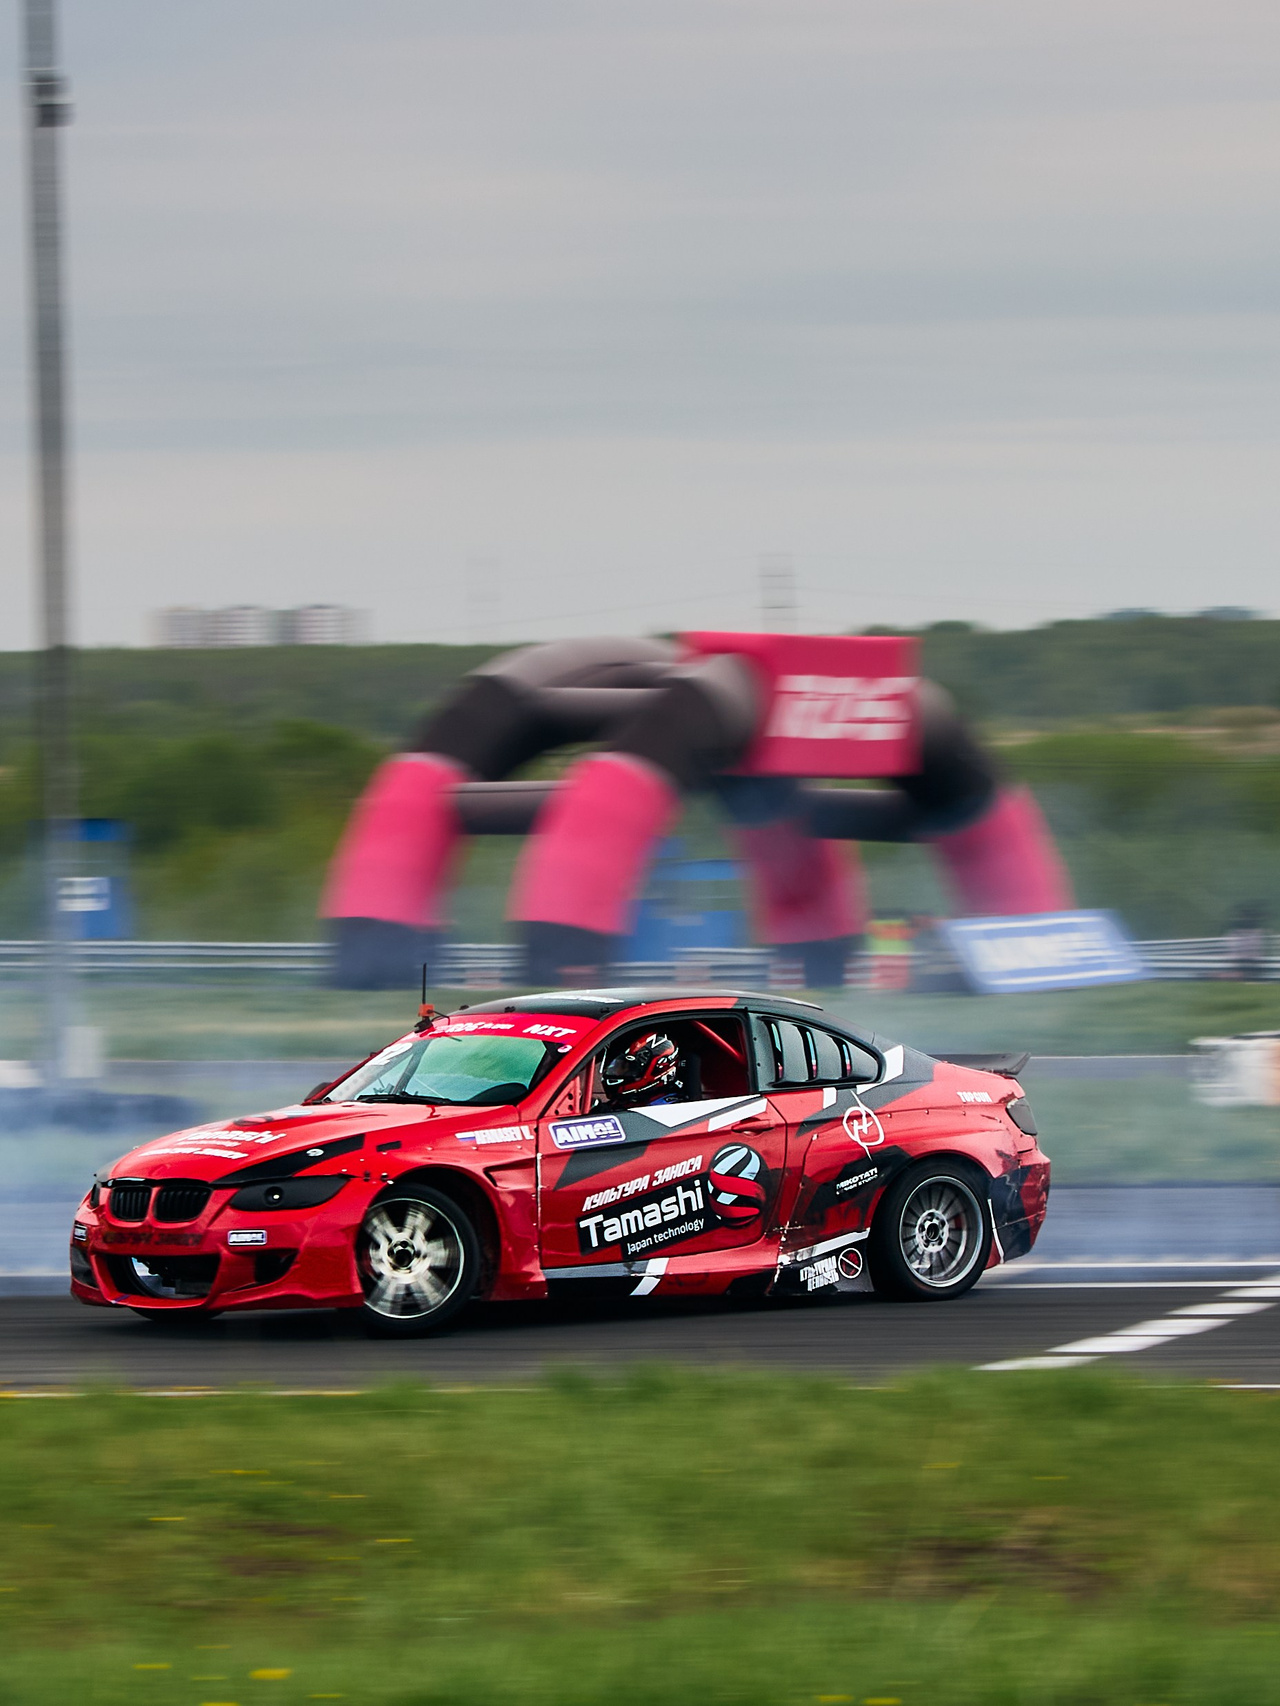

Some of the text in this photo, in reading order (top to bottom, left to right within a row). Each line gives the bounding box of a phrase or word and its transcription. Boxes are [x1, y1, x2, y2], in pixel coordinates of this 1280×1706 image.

[522, 1023, 577, 1038] NXT
[956, 1091, 993, 1103] TOPGUN
[556, 1120, 621, 1144] AIMOL
[582, 1154, 703, 1212] КУЛЬТУРА ЗАНОСА
[579, 1179, 705, 1248] Tamashi
[654, 1217, 705, 1243] technology
